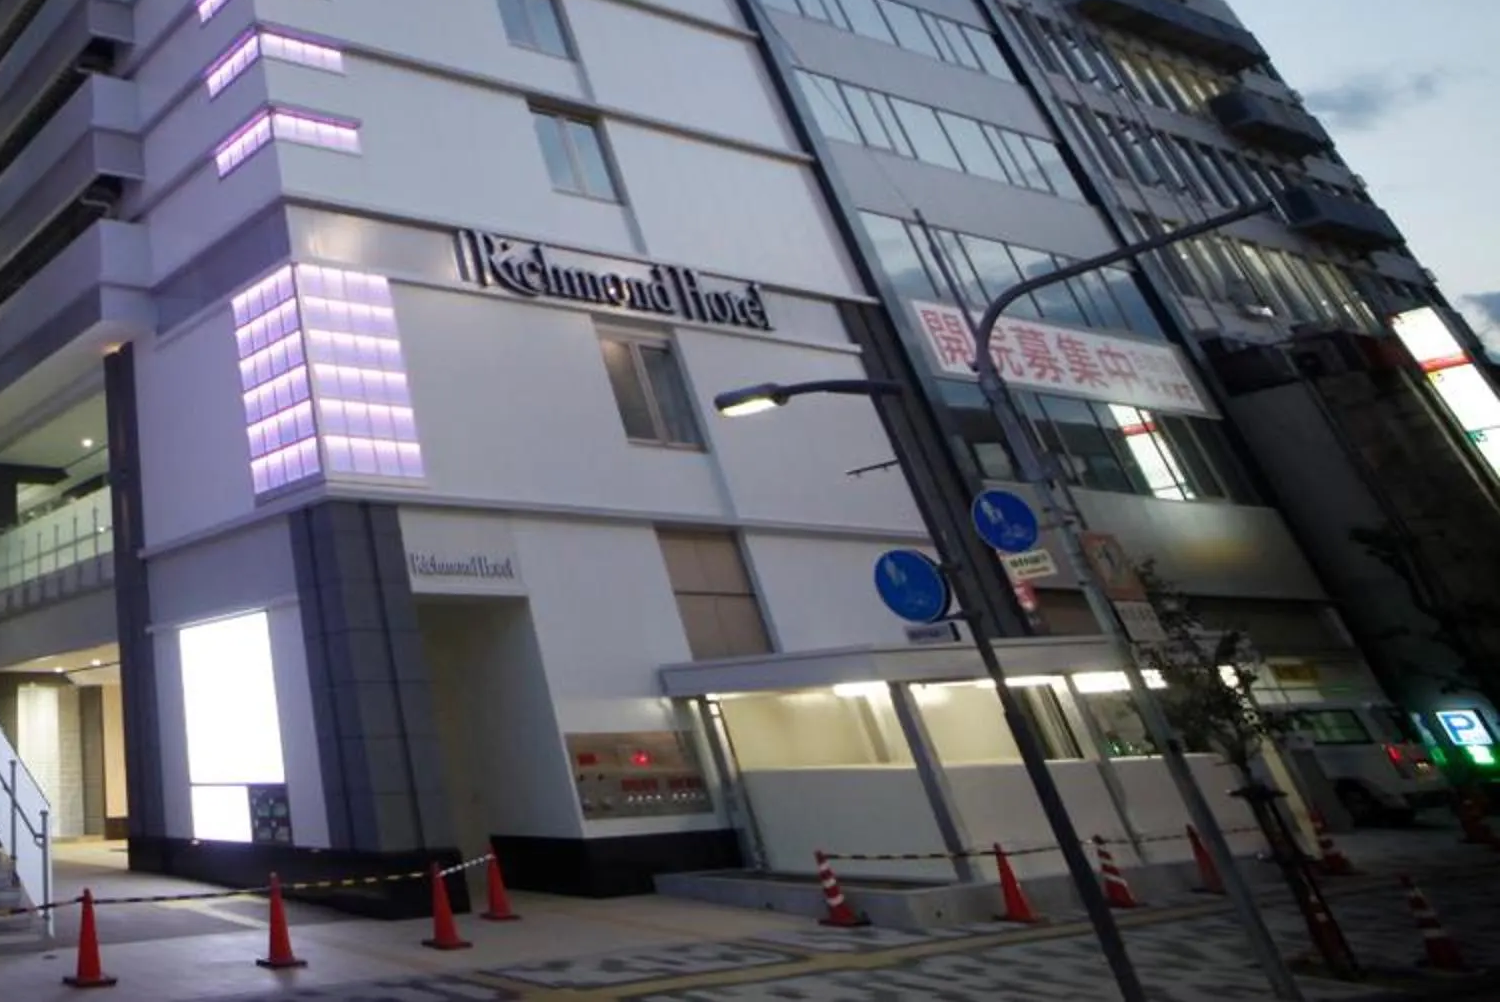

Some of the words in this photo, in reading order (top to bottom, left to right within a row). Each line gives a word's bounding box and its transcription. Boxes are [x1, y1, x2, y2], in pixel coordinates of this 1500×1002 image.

[455, 228, 676, 315] Richmond
[666, 265, 775, 331] Hotel
[1442, 713, 1475, 742] P
